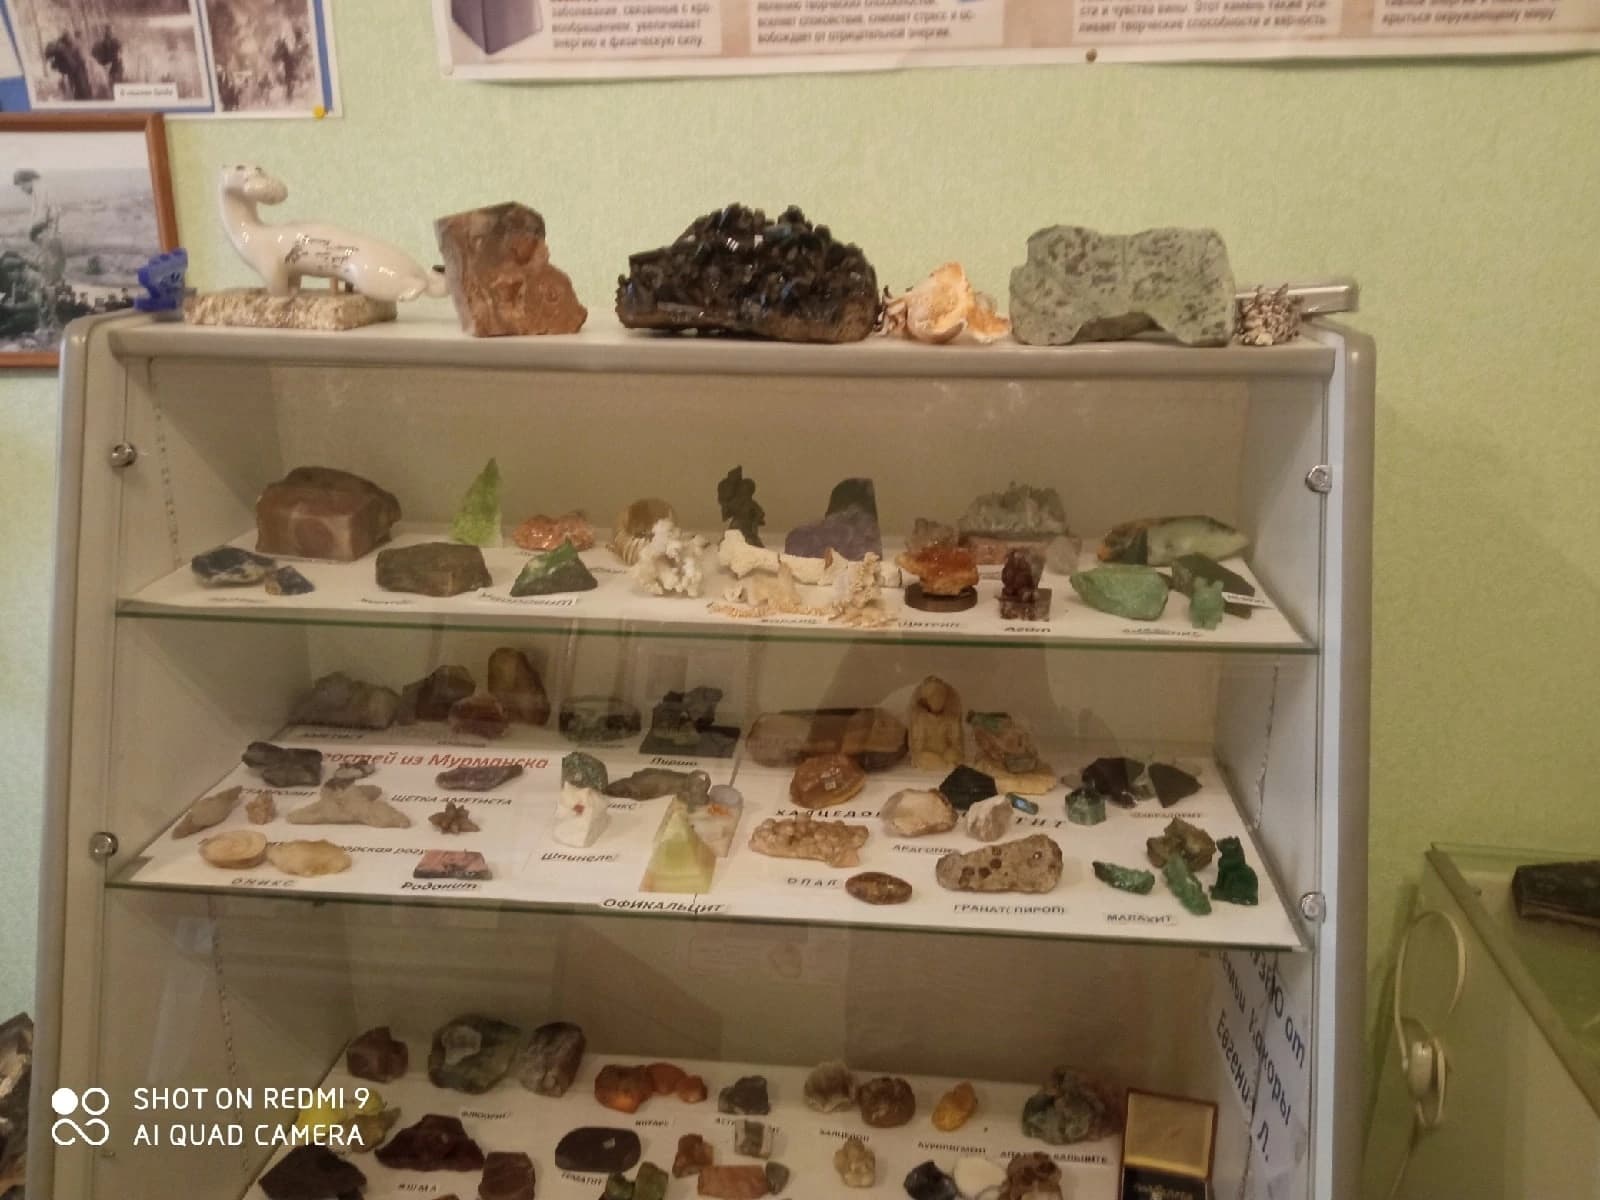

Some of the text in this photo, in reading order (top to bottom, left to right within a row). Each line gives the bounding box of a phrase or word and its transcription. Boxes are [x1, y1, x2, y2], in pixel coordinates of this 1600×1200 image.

[400, 755, 424, 766] из
[428, 753, 549, 769] Мурманска
[343, 844, 393, 854] орская
[231, 877, 298, 888] ОНИКС
[400, 880, 477, 891] Родонит
[787, 877, 839, 888] ОПАЛ
[602, 898, 725, 913] ОФИКАЛЬЦИТ
